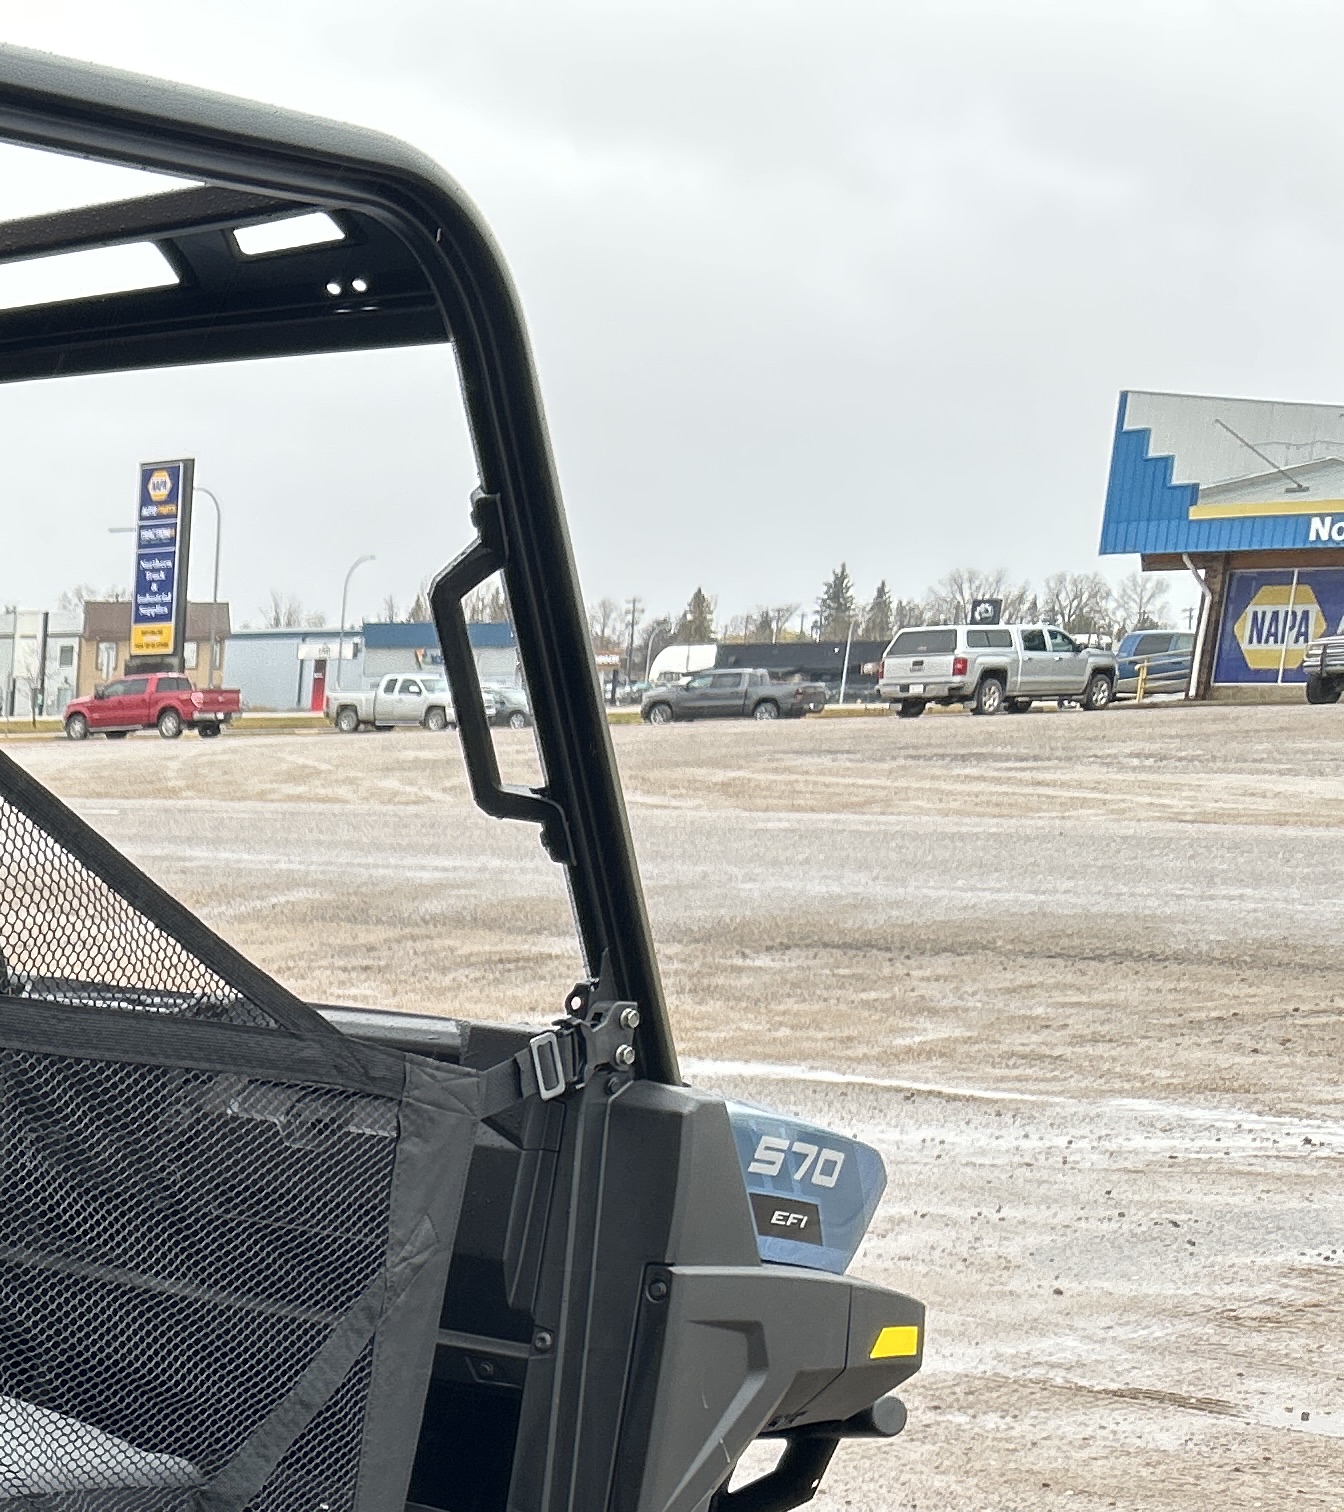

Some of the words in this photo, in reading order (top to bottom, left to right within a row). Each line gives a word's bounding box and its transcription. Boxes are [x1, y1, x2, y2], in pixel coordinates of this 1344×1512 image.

[1248, 610, 1309, 645] NAPA
[748, 1136, 844, 1188] 570
[771, 1211, 808, 1228] EFI
